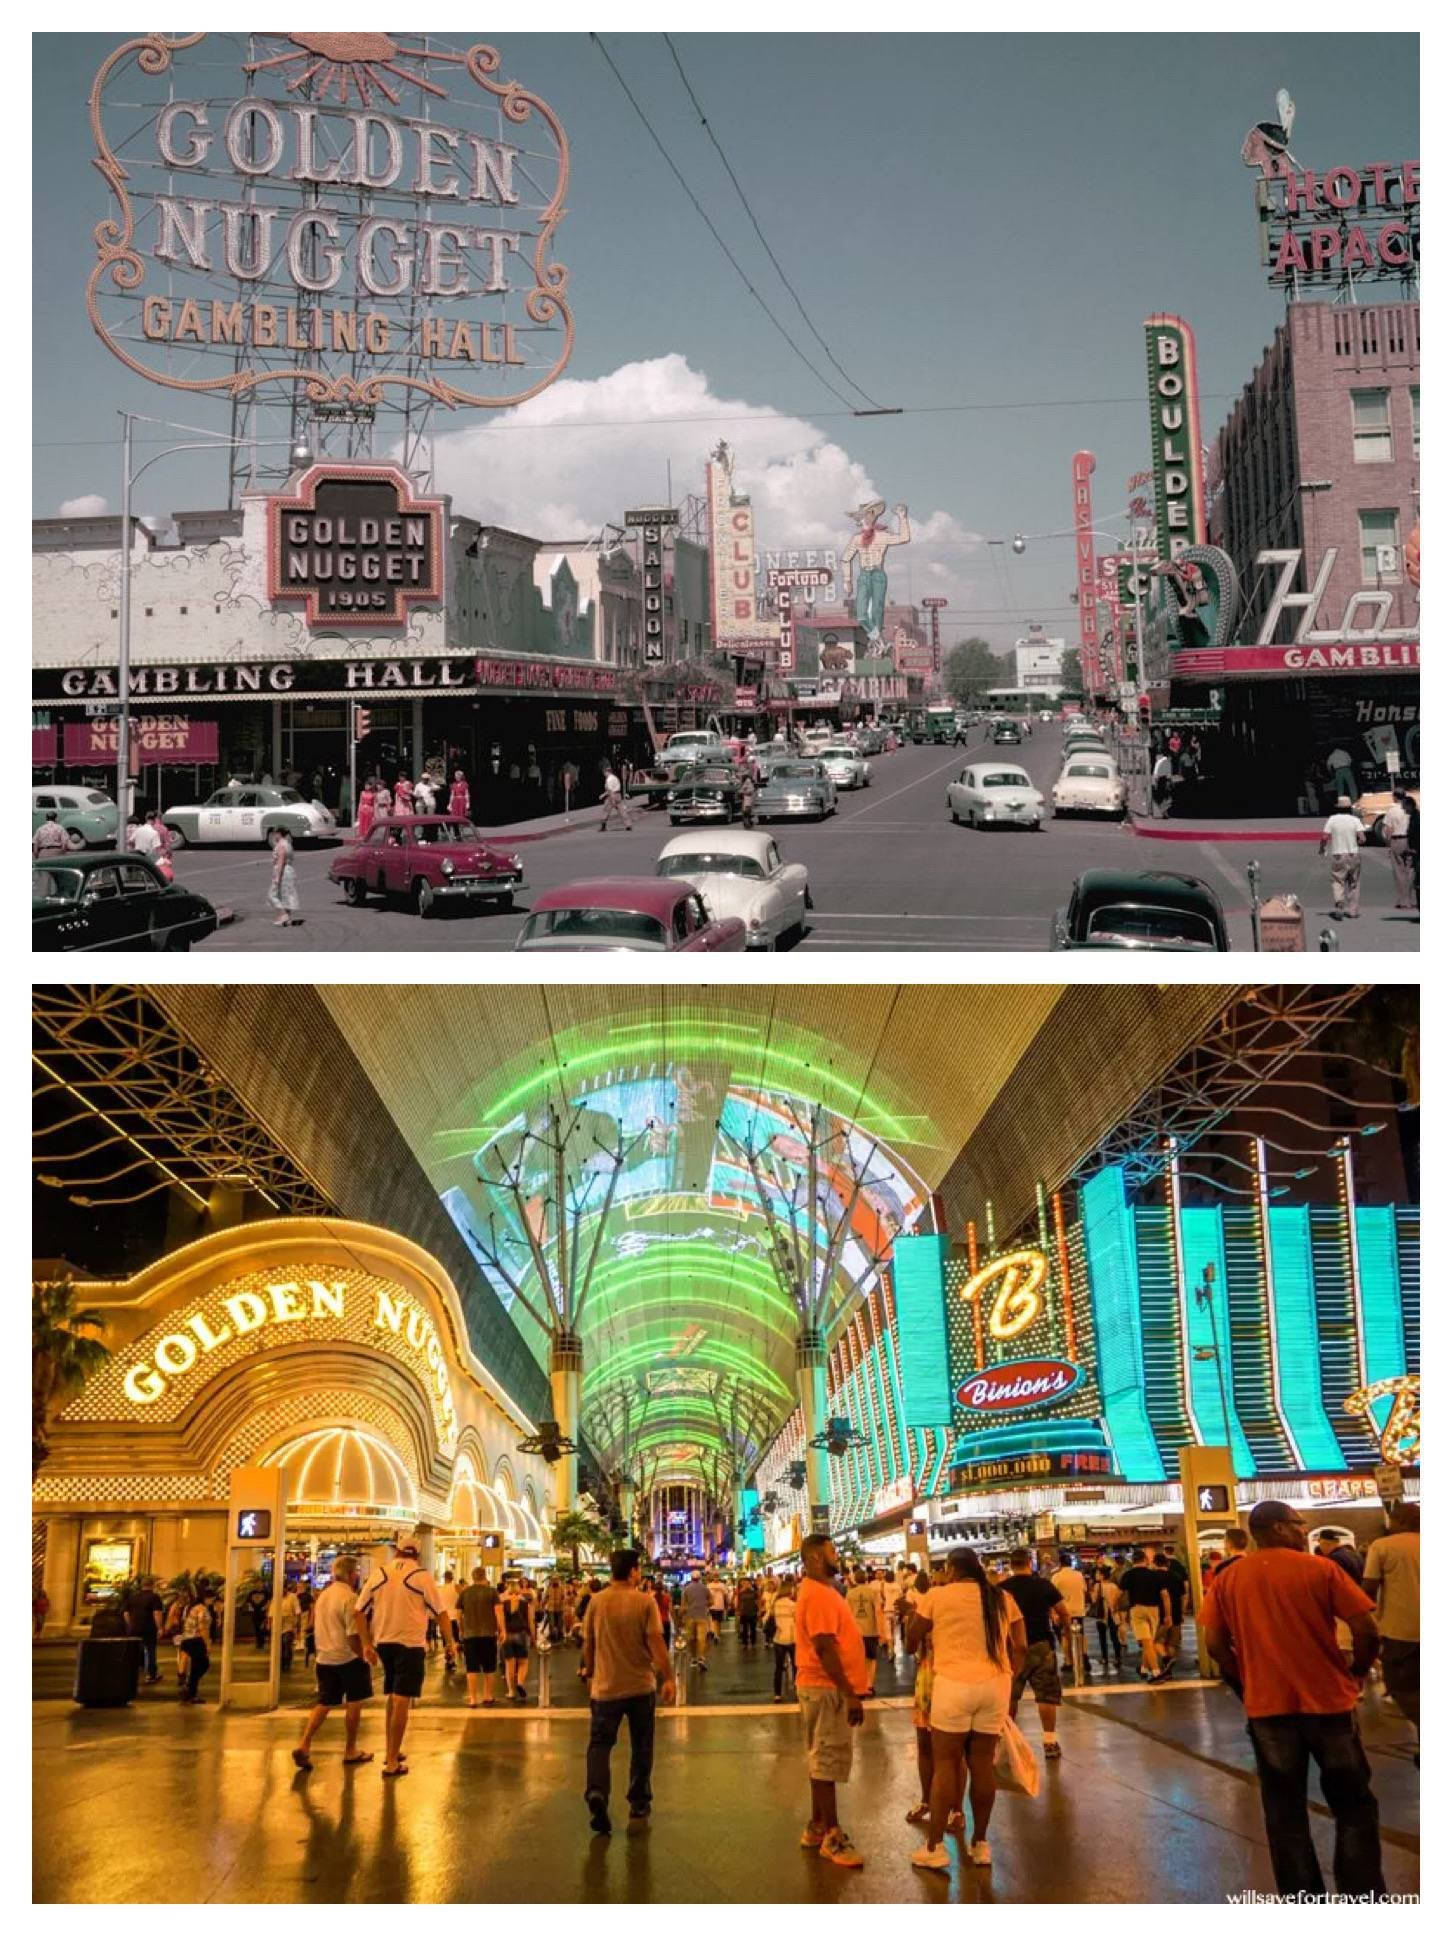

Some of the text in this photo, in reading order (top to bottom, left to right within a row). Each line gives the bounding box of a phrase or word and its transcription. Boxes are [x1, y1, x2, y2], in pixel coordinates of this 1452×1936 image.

[156, 97, 519, 202] GOLDEN
[154, 199, 519, 296] NUGGET
[143, 296, 525, 364] GAMBLING HALL
[288, 516, 425, 546] GOLDEN
[288, 551, 425, 580] NUGGET
[732, 511, 751, 618] CLUB
[769, 568, 829, 586] Fortune
[328, 590, 387, 607] 1905
[645, 527, 661, 657] SALOON
[779, 592, 792, 668] CLUB
[1284, 646, 1419, 667] GAMBLI
[62, 666, 295, 696] GAMBLING
[344, 660, 466, 688] HALL
[91, 714, 190, 732] GODEN
[1356, 700, 1419, 722] Hors
[91, 732, 189, 751] NUGET
[959, 1248, 1048, 1339] B
[123, 1279, 347, 1406] GOLDEN
[964, 1369, 1067, 1405] Binion's
